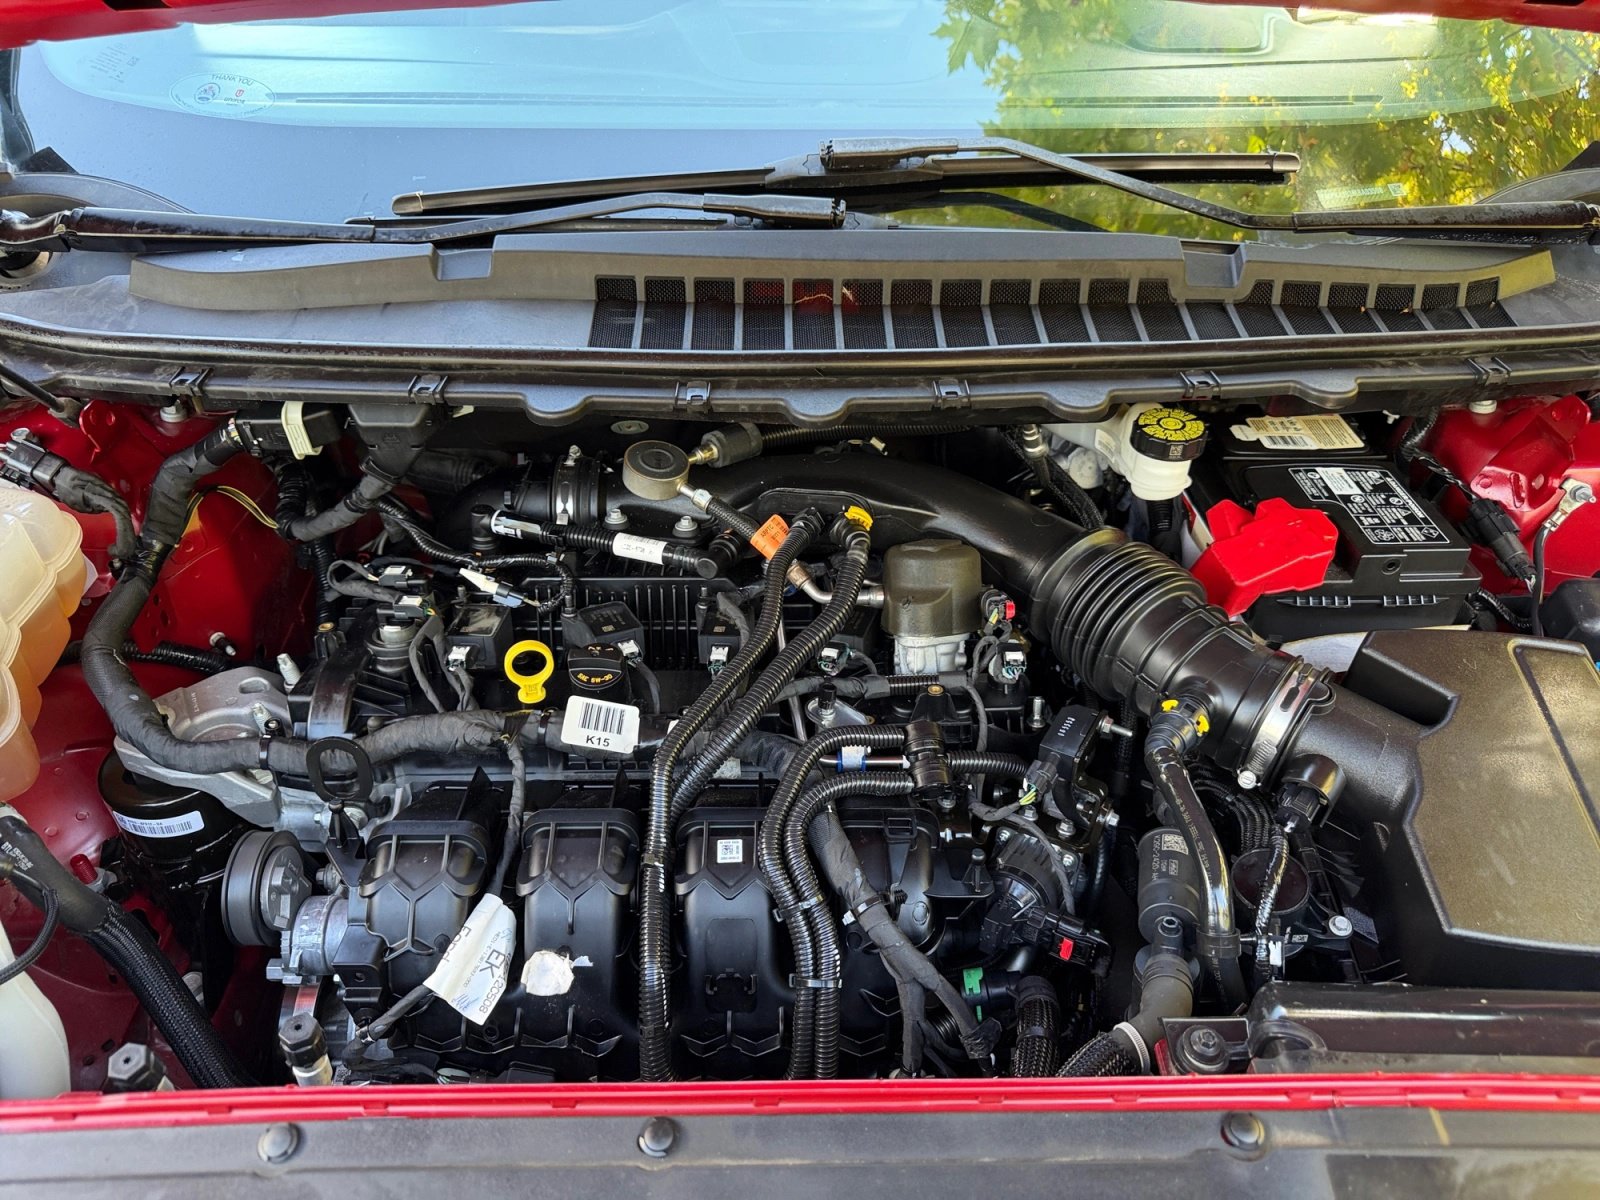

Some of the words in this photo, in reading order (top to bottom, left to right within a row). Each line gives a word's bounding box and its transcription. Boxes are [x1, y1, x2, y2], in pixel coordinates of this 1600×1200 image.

[211, 74, 236, 82] THANK
[239, 78, 254, 86] YOU
[586, 735, 610, 747] K15
[479, 948, 506, 979] EK
